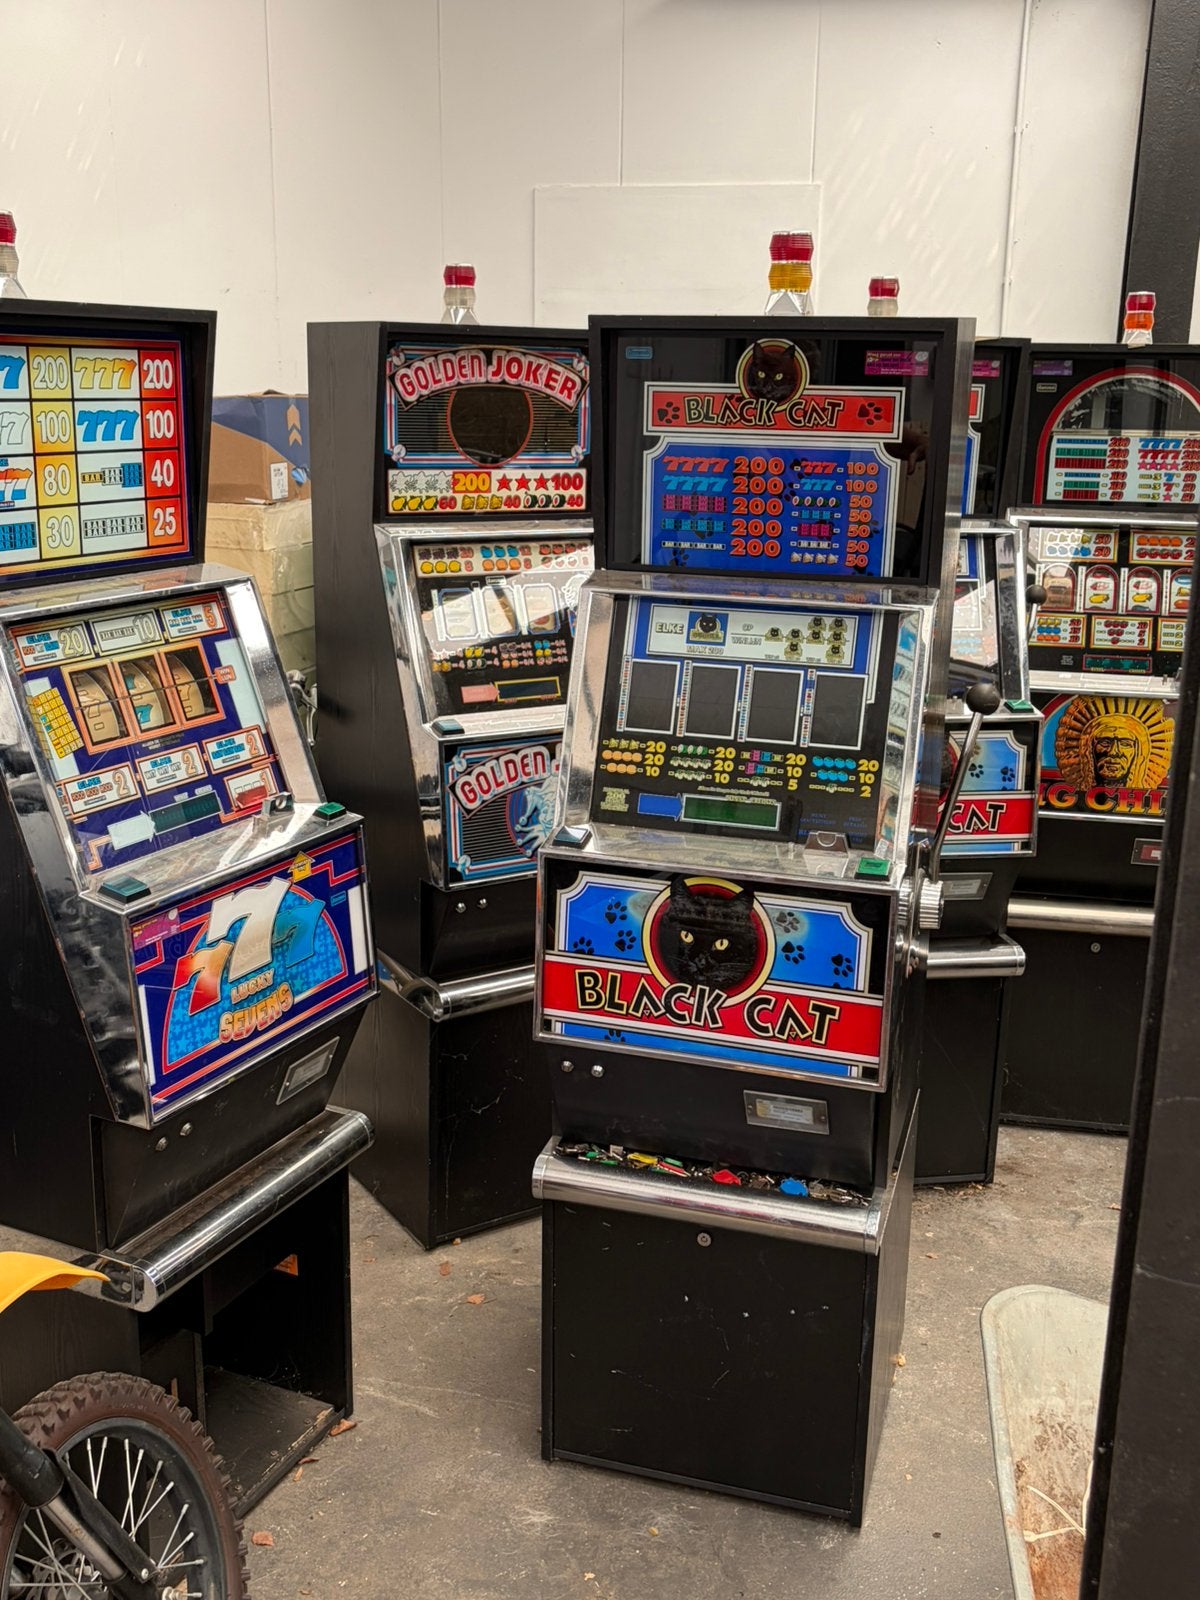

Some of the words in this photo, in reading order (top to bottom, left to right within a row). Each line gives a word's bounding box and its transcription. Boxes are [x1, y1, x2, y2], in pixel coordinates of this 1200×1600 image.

[32, 355, 69, 390] 200
[74, 357, 137, 390] 777
[143, 358, 174, 390] 200
[396, 352, 486, 401] GOLDEN
[490, 352, 579, 403] JOKER
[684, 396, 777, 427] BLACK
[786, 398, 844, 428] CAT
[36, 410, 71, 444] 100
[77, 410, 139, 443] 777
[145, 409, 175, 439] 100
[151, 458, 174, 488] 40
[662, 456, 729, 472] 7777
[732, 456, 785, 475] 200
[801, 462, 838, 474] 777
[847, 462, 879, 475] 100
[43, 463, 71, 497] 80
[453, 471, 491, 491] 200
[551, 472, 584, 491] 100
[662, 475, 728, 492] 7777
[731, 475, 784, 495] 200
[846, 480, 878, 493] 100
[503, 495, 521, 509] 40
[566, 493, 584, 508] 40
[730, 497, 783, 516] 200
[849, 495, 872, 508] 50
[152, 506, 176, 536] 25
[849, 509, 872, 523] 50
[46, 515, 74, 548] 30
[730, 518, 782, 537] 200
[848, 525, 870, 538] 50
[729, 538, 781, 557] 200
[846, 540, 869, 553] 50
[1093, 533, 1112, 545] 50
[845, 554, 869, 567] 50
[1093, 546, 1112, 557] 50
[203, 604, 217, 628] 5
[134, 614, 157, 641] 10
[655, 622, 684, 634] ELKE
[58, 627, 85, 657] 20
[246, 734, 260, 756] 2
[646, 741, 666, 753] 20
[714, 747, 736, 759] 20
[182, 750, 197, 777] 2
[644, 754, 665, 765] 20
[713, 760, 734, 771] 20
[785, 753, 806, 765] 20
[857, 759, 879, 771] 20
[457, 748, 548, 806] GOLDEN
[645, 766, 660, 777] 10
[714, 772, 730, 783] 10
[786, 766, 802, 777] 10
[859, 773, 875, 784] 10
[113, 770, 131, 797] 2
[787, 779, 798, 790] 5
[859, 785, 871, 797] 2
[1086, 786, 1166, 816] CHI
[948, 801, 1007, 833] CAT
[231, 967, 274, 1003] LUCKY
[218, 981, 294, 1043] SEVENS
[575, 969, 727, 1029] BLACK
[743, 995, 840, 1045] CAT
